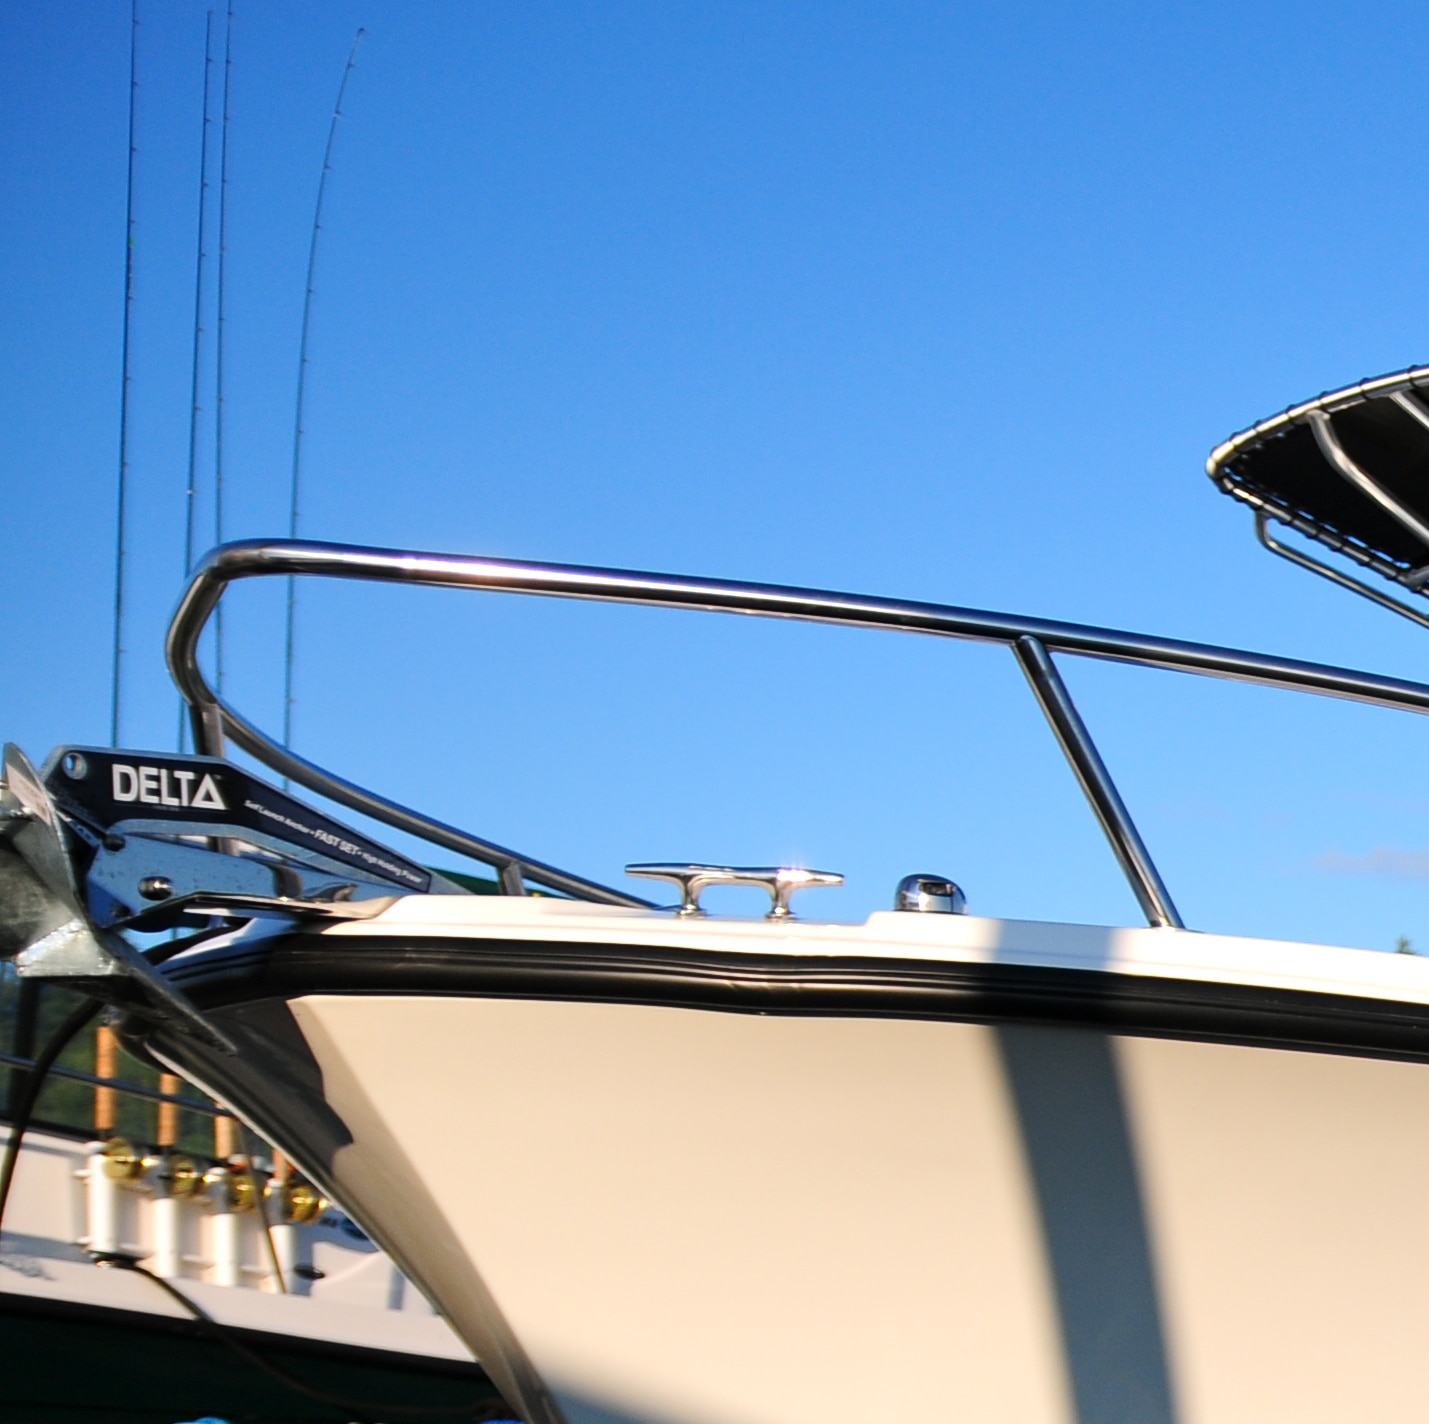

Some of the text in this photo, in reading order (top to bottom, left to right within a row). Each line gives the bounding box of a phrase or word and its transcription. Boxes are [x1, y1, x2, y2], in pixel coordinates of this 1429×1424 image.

[111, 763, 226, 810] DELTA
[314, 829, 341, 847] FAST
[339, 841, 361, 855] SET
